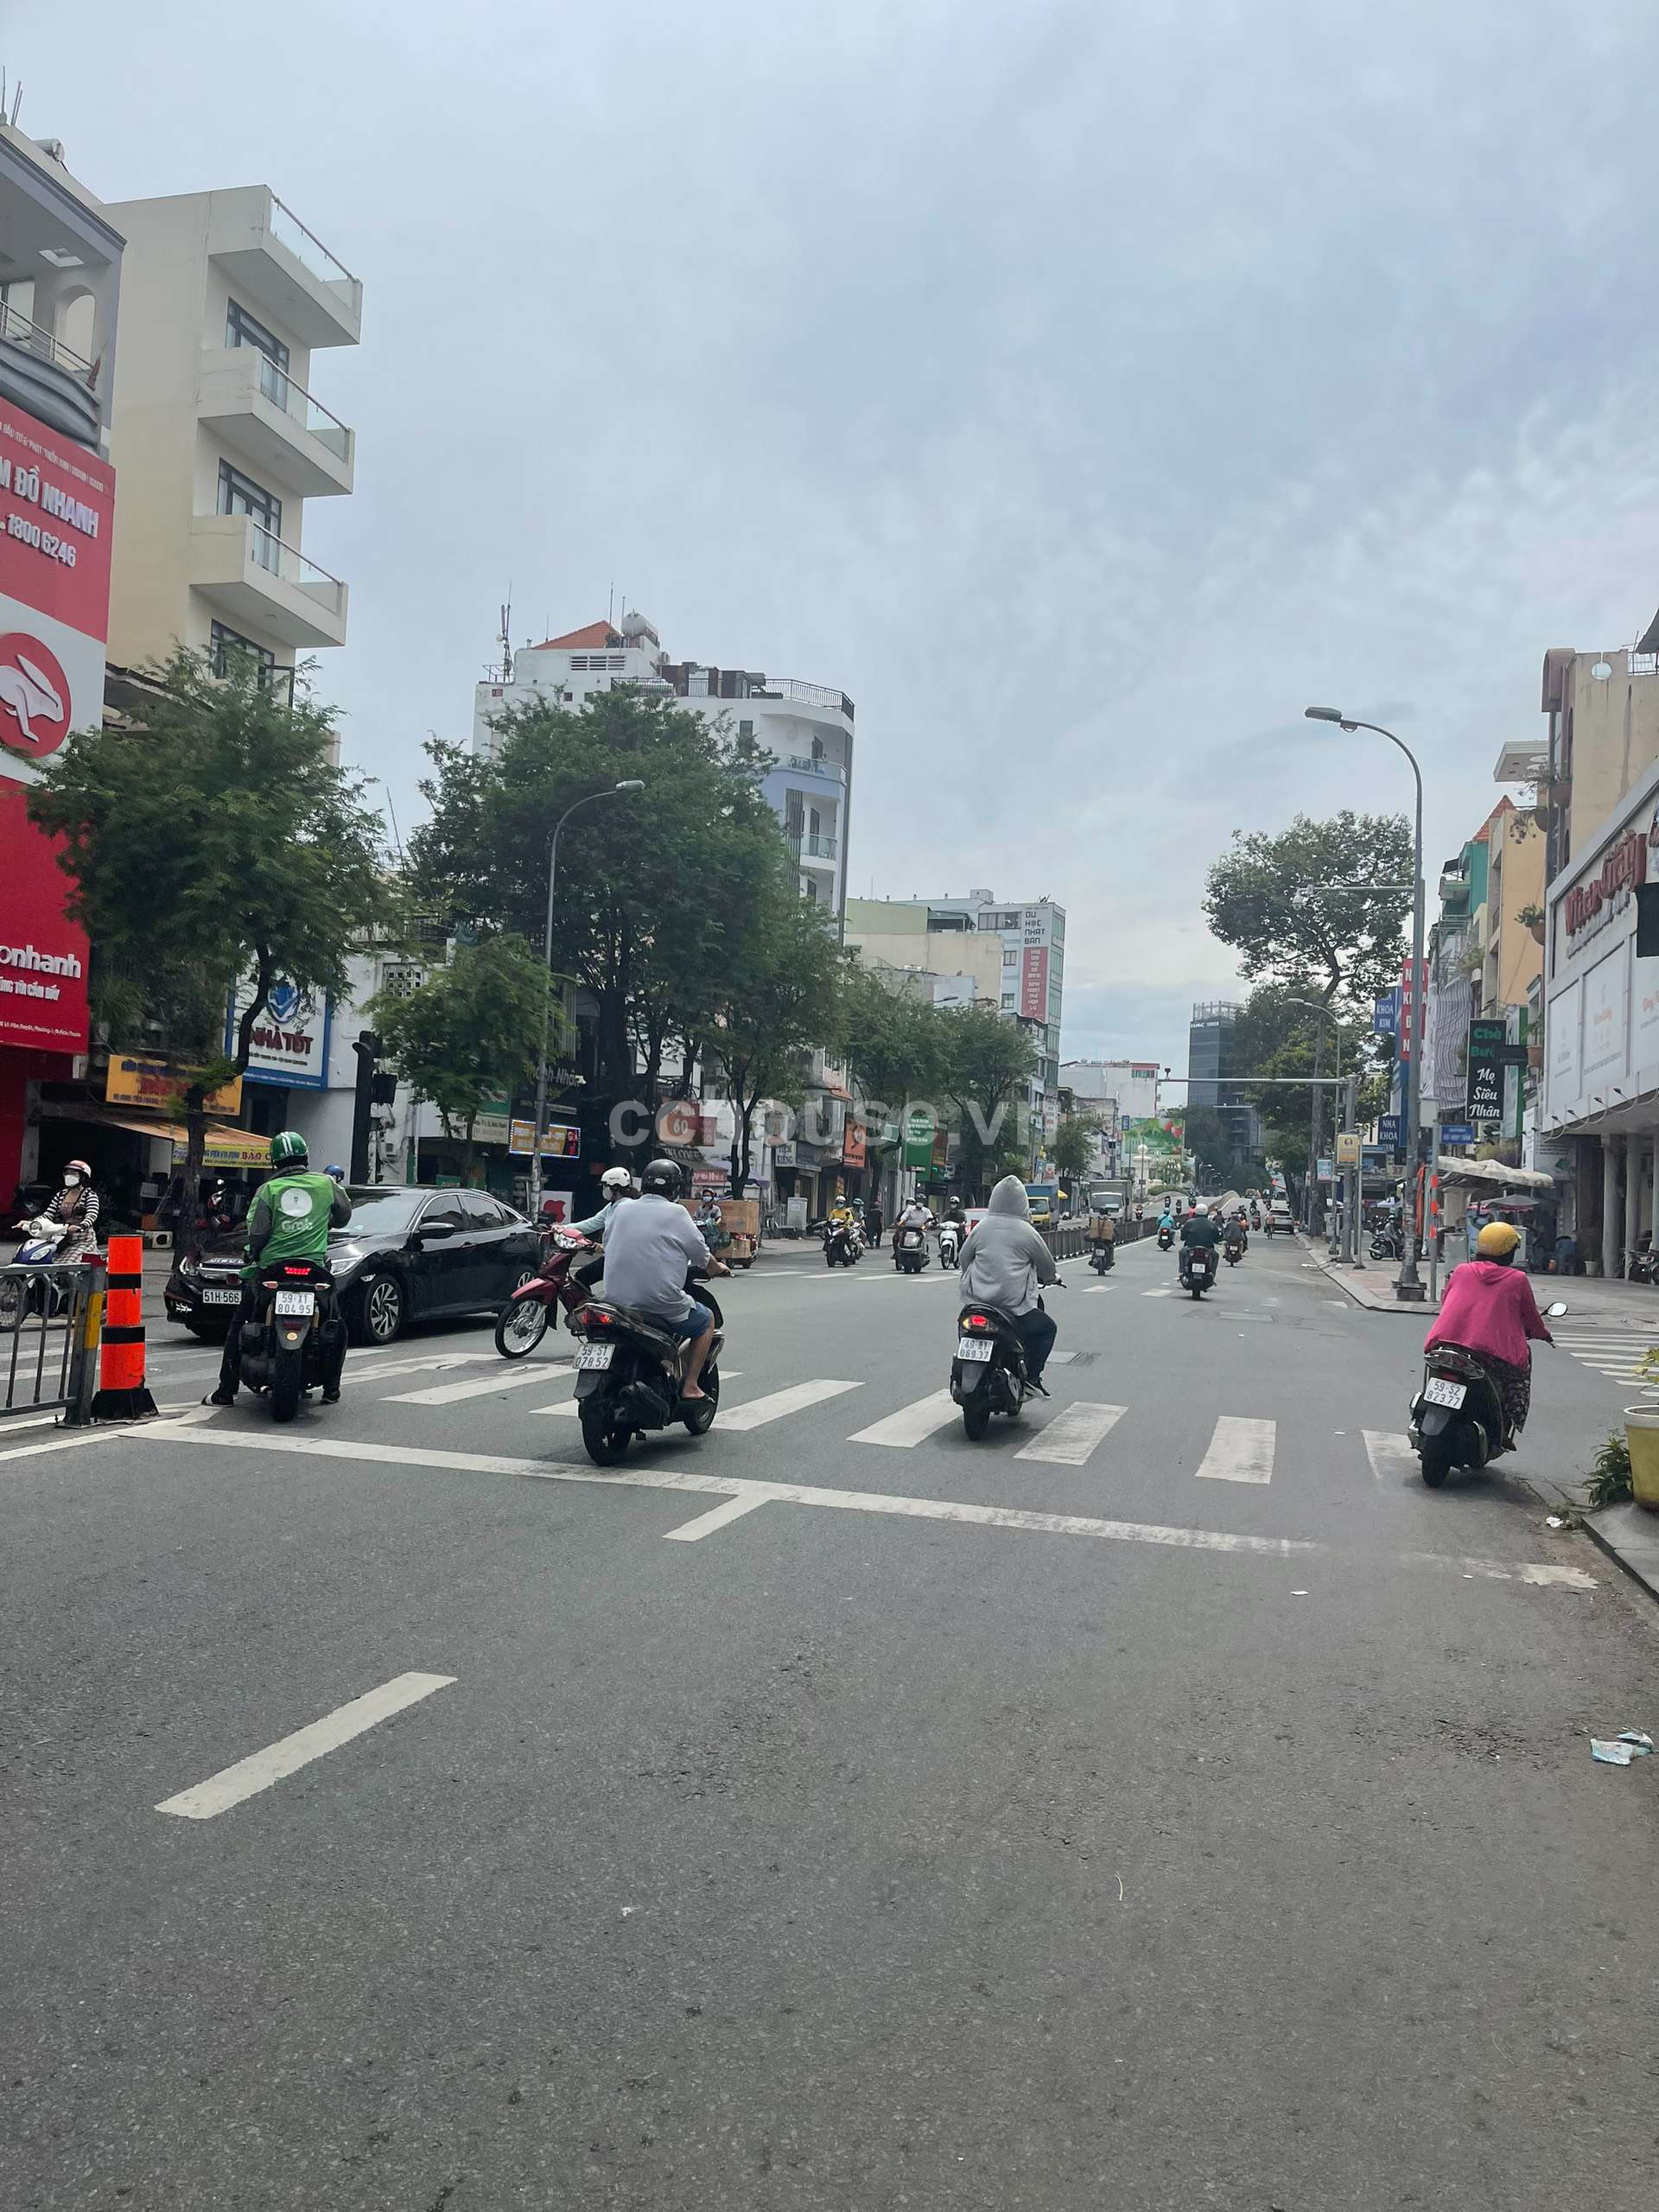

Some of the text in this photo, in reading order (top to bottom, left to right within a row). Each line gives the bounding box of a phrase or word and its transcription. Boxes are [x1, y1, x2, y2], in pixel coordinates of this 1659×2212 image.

[41, 482, 99, 539] NHANH
[7, 513, 77, 568] 1800 6246
[1376, 1004, 1395, 1014] KHOA
[1379, 1018, 1391, 1028] KIM
[1478, 1068, 1496, 1084] Mẹ
[1470, 1104, 1500, 1117] Nhân
[1382, 1119, 1396, 1128] NHA
[1379, 1132, 1398, 1141] KHOA
